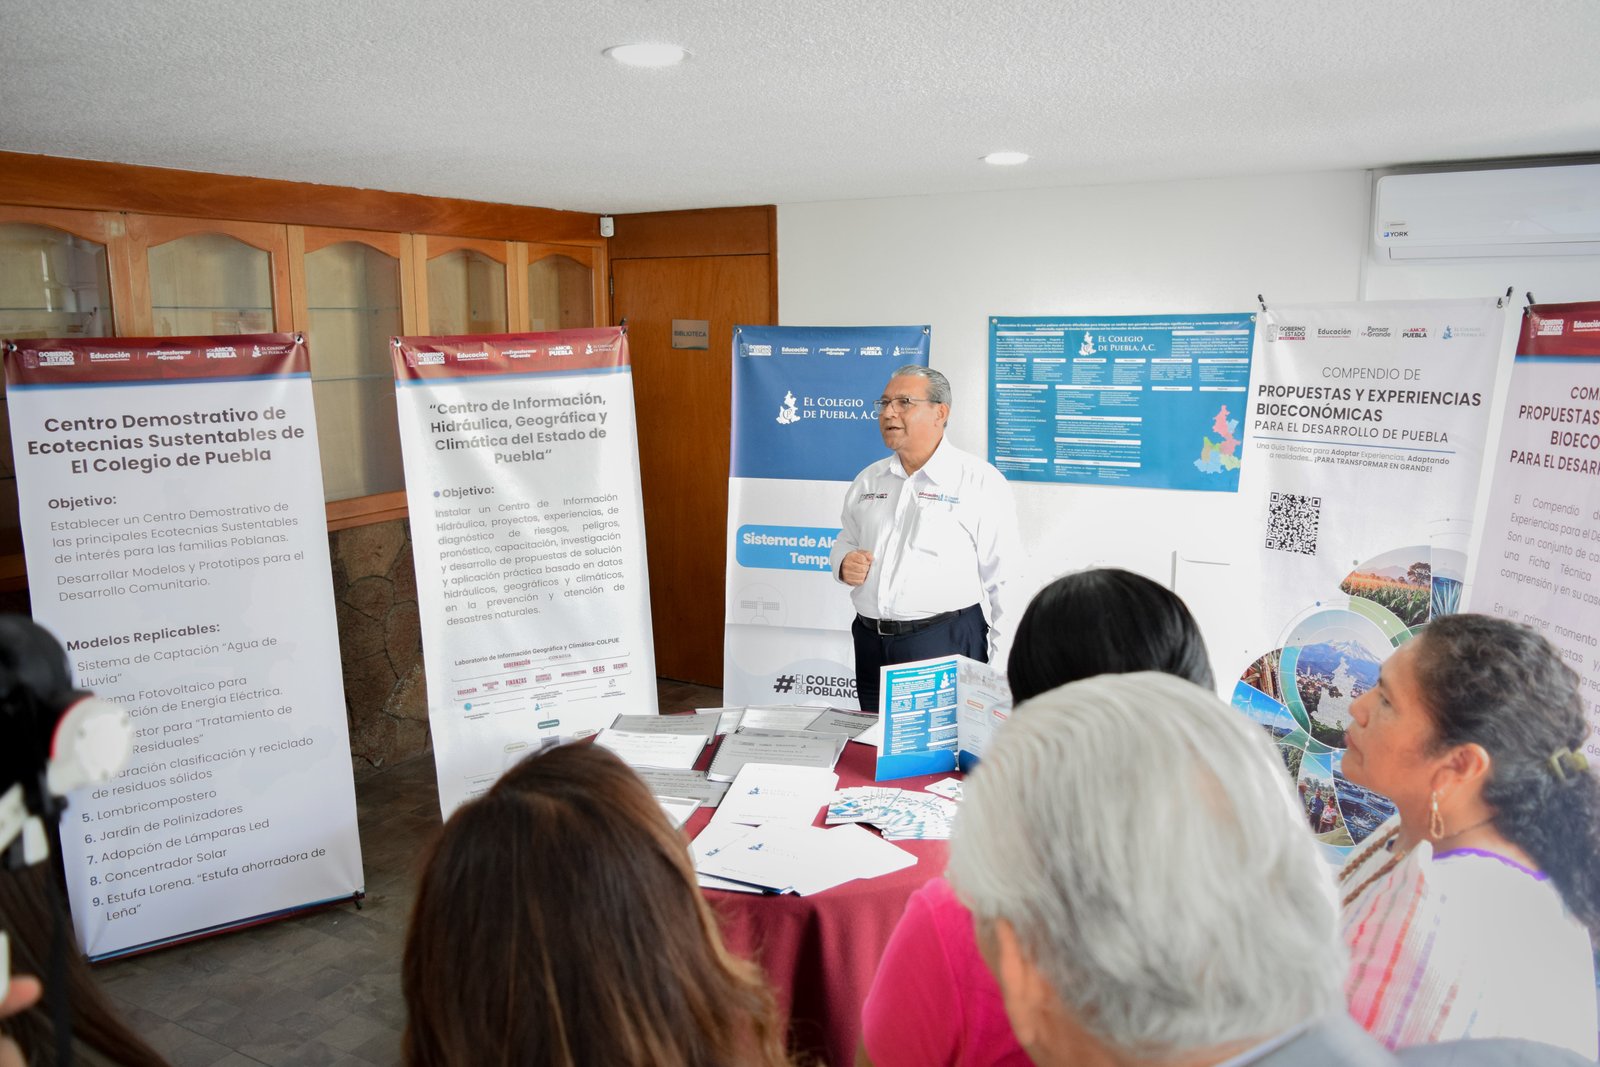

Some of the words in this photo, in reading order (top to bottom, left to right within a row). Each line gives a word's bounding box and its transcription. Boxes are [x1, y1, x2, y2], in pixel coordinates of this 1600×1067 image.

[674, 330, 707, 338] BIBLIOTECA
[1108, 335, 1143, 343] COLEGIO
[1321, 366, 1400, 381] COMPENDIO
[1403, 368, 1421, 381] DE
[490, 399, 510, 412] de
[512, 392, 606, 410] Información,
[817, 397, 864, 408] COLEGIO
[1258, 384, 1352, 401] PROPUESTAS
[1355, 388, 1365, 402] Y
[1367, 389, 1482, 407] EXPERIENCIAS
[44, 416, 118, 433] Centro
[121, 407, 259, 429] Demostrativo
[262, 406, 286, 421] de
[430, 417, 513, 433] Hidráulica,
[515, 410, 596, 429] Geográfica
[598, 411, 608, 425] y
[1256, 402, 1383, 423] BIOECONÓMICAS
[1519, 404, 1600, 425] PROPUESTAS
[27, 434, 144, 455] Ecotecnias
[148, 427, 277, 448] Sustentables
[281, 425, 305, 439] de
[435, 434, 508, 451] Climática
[511, 432, 534, 445] del
[536, 428, 586, 443] Estado
[588, 427, 607, 439] de
[1254, 419, 1284, 432] PARA
[1287, 422, 1299, 433] EL
[1301, 423, 1379, 439] DESARROLLO
[1382, 428, 1398, 440] DE
[1401, 429, 1448, 443] PUEBLA
[1550, 430, 1600, 450] BIOECO
[71, 458, 88, 474] El
[92, 453, 172, 474] Colegio
[175, 452, 201, 467] de
[204, 447, 272, 465] Puebla
[1336, 457, 1389, 469] TRANSFORMAR
[1389, 462, 1399, 470] EN
[1509, 449, 1541, 467] PARA
[1544, 454, 1555, 469] EL
[47, 495, 117, 509] Objetivo:
[442, 485, 495, 500] Objetivo:
[50, 518, 120, 532] Establecer
[123, 515, 140, 525] un
[142, 512, 186, 524] Centro
[189, 504, 272, 520] Demostrativo
[273, 502, 289, 512] de
[436, 519, 488, 532] Hidráulica,
[491, 514, 540, 528] proyectos,
[543, 508, 604, 522] experiencias,
[607, 506, 620, 515] de
[52, 537, 73, 548] las
[75, 530, 148, 549] principales
[150, 524, 219, 539] Ecotecnias
[221, 517, 299, 532] Sustentables
[743, 532, 797, 547] Sistema
[799, 535, 816, 547] de
[54, 553, 72, 564] de
[75, 550, 121, 562] interés
[123, 546, 155, 560] para
[157, 544, 176, 554] las
[178, 538, 228, 552] familias
[230, 534, 289, 547] Poblanas.
[439, 545, 493, 561] pronóstico,
[494, 538, 559, 554] capacitación,
[560, 531, 622, 546] investigación
[58, 585, 126, 602] Desarrollo
[128, 576, 210, 594] Comunitario.
[66, 635, 131, 652] Modelos
[133, 623, 220, 644] Replicables:
[77, 657, 131, 672] Sistema
[133, 653, 151, 664] de
[153, 644, 219, 662] Captación
[261, 636, 277, 647] de
[454, 656, 489, 667] Laboratorio
[496, 649, 532, 660] Información
[532, 645, 564, 655] Geográfica
[503, 659, 531, 668] GOBERNACIÓN
[138, 681, 215, 700] Fotovoltaico
[218, 677, 247, 691] para
[505, 677, 527, 686] FINANZAS
[806, 675, 857, 689] COLEGIO
[806, 686, 859, 699] POBLANO
[91, 789, 109, 800] de
[112, 778, 167, 796] residuos
[169, 770, 213, 785] sólidos
[81, 812, 94, 823] 5.
[97, 790, 217, 821] Lombricompostero
[84, 833, 97, 844] 6.
[100, 825, 141, 841] Jardín
[143, 821, 160, 833] de
[163, 805, 243, 828] Polinizadores
[86, 855, 98, 865] 7.
[101, 842, 163, 863] Adopción
[165, 837, 182, 848] de
[184, 825, 247, 845] Lámparas
[249, 818, 270, 831] Led
[89, 875, 102, 887] 8.
[104, 856, 193, 883] Concentrador
[196, 849, 227, 863] Solar
[92, 896, 104, 907] 9.
[107, 888, 146, 905] Estufa
[149, 878, 194, 894] Lorena.
[241, 852, 309, 873] ahorradora
[310, 848, 326, 858] de
